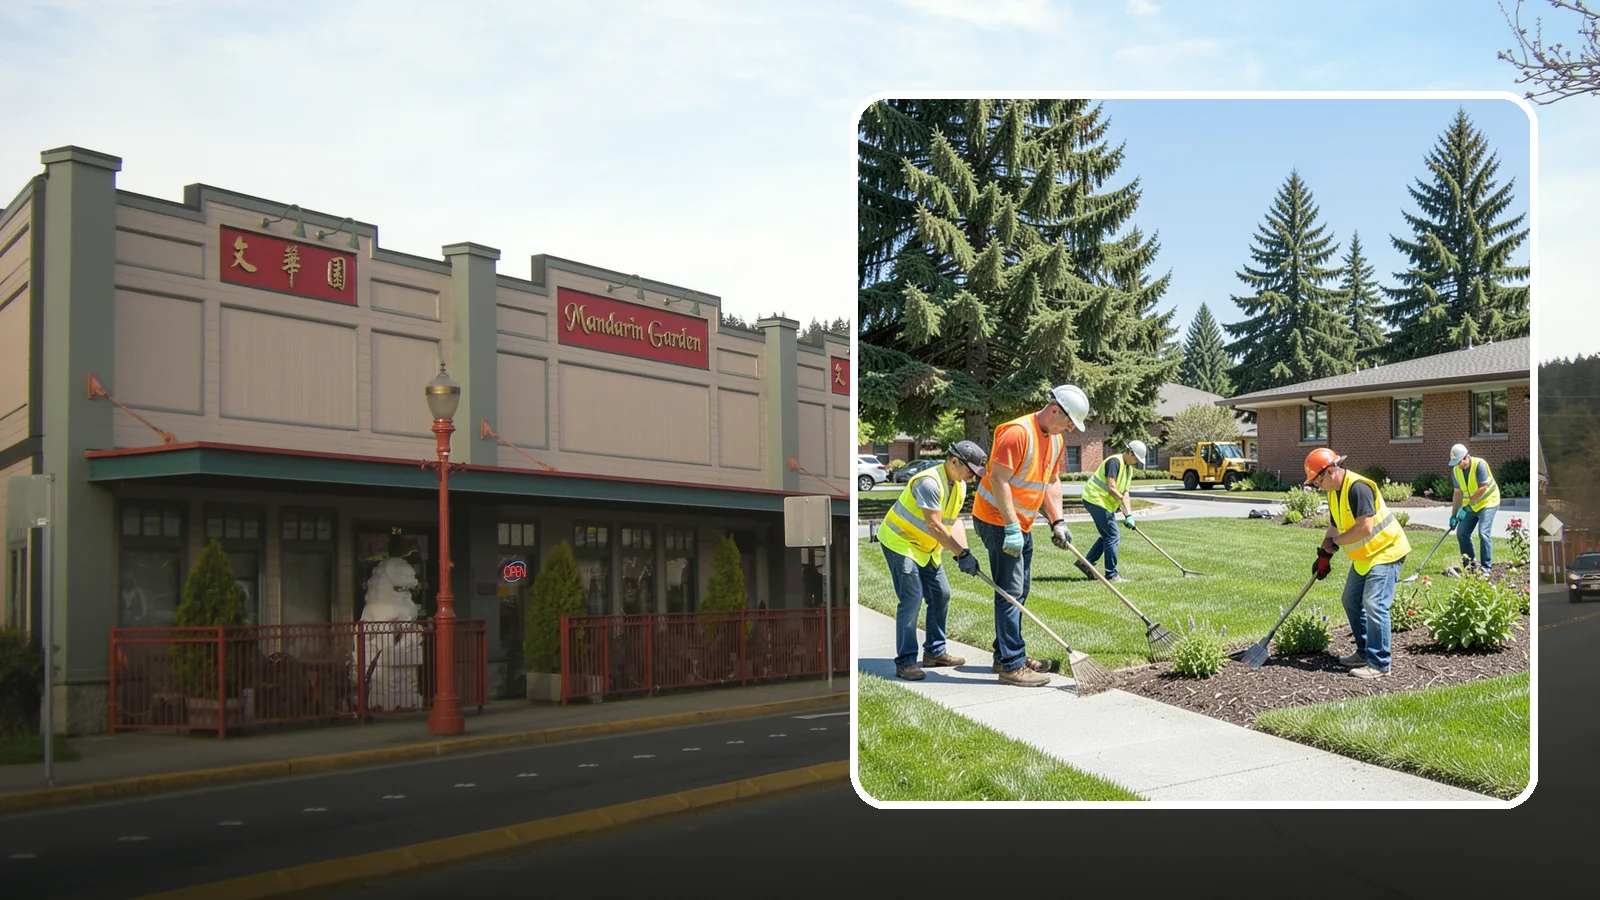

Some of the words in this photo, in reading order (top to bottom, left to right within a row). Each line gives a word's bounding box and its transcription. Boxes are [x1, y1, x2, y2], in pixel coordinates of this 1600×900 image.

[230, 235, 346, 291] 文華園
[564, 302, 644, 341] Mandarin
[647, 320, 701, 351] Garden
[503, 565, 527, 578] OPEN
